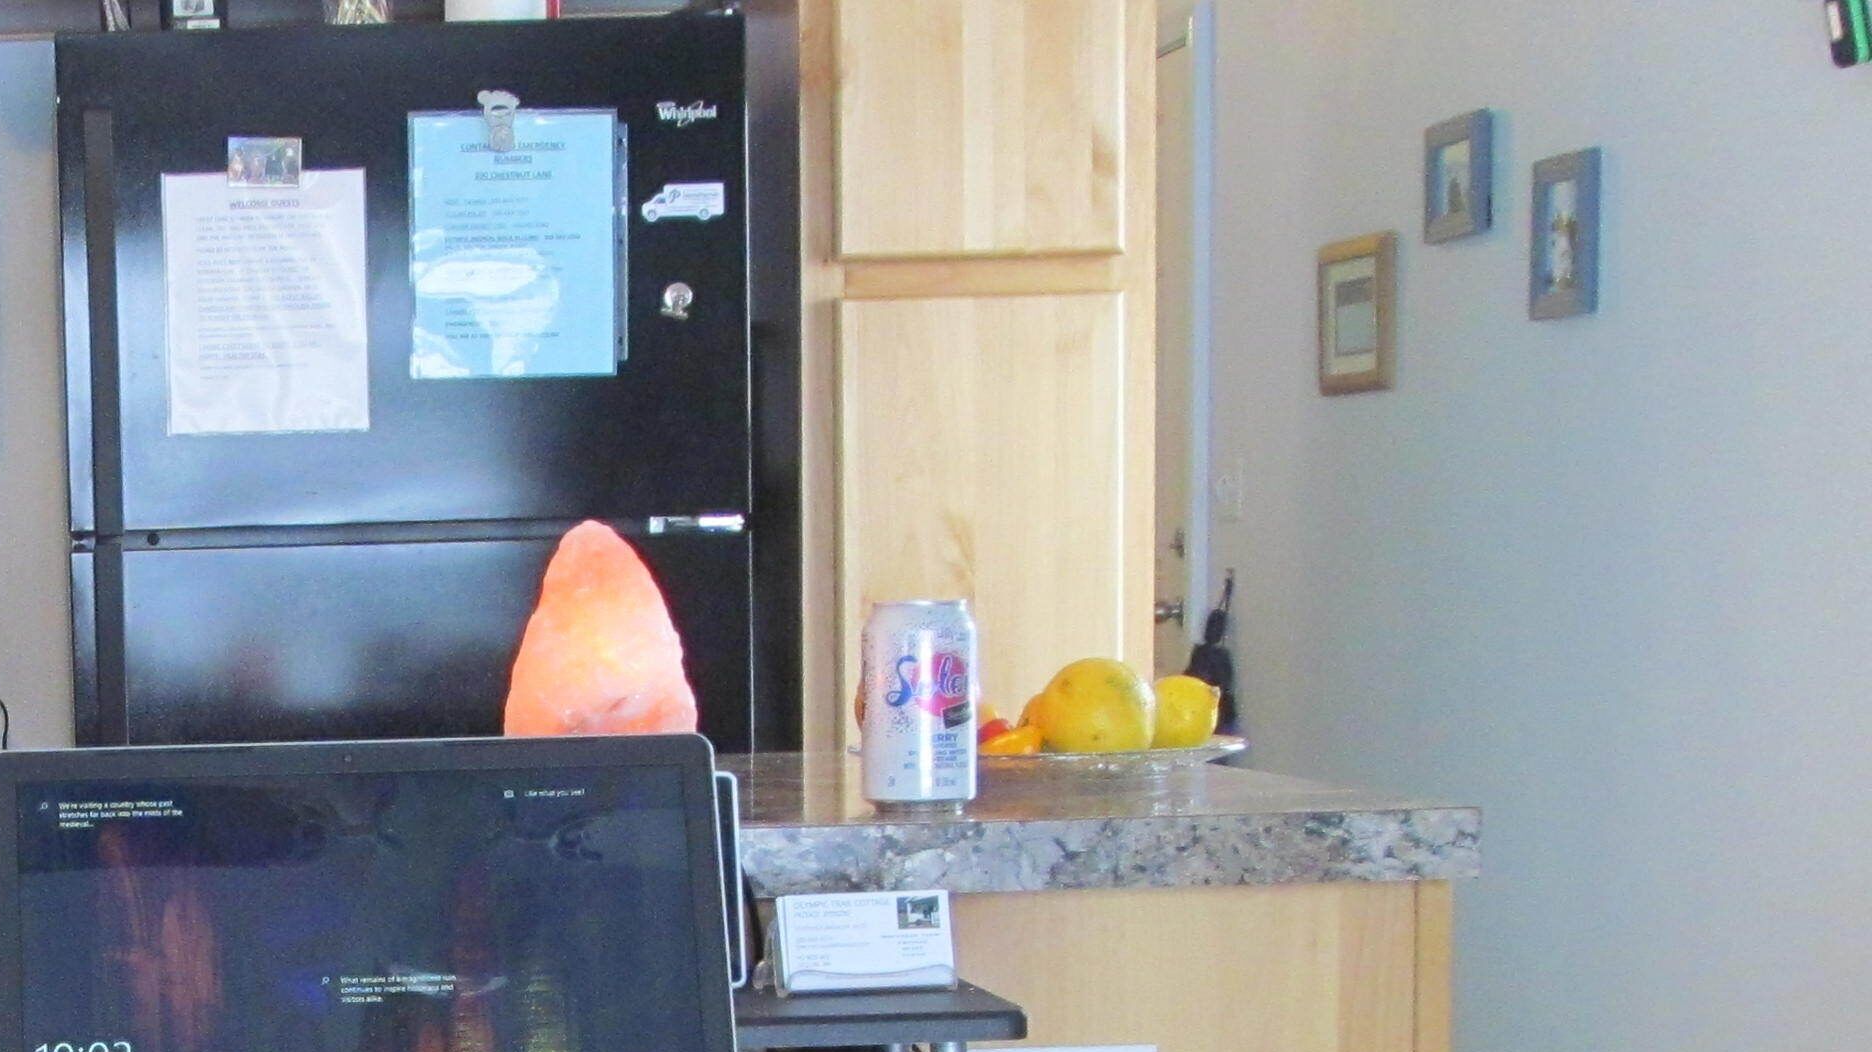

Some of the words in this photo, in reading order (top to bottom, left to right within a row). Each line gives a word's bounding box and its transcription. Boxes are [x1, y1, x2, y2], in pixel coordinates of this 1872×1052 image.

[657, 103, 716, 123] Whirlpool
[110, 801, 134, 810] country
[341, 986, 373, 994] continues
